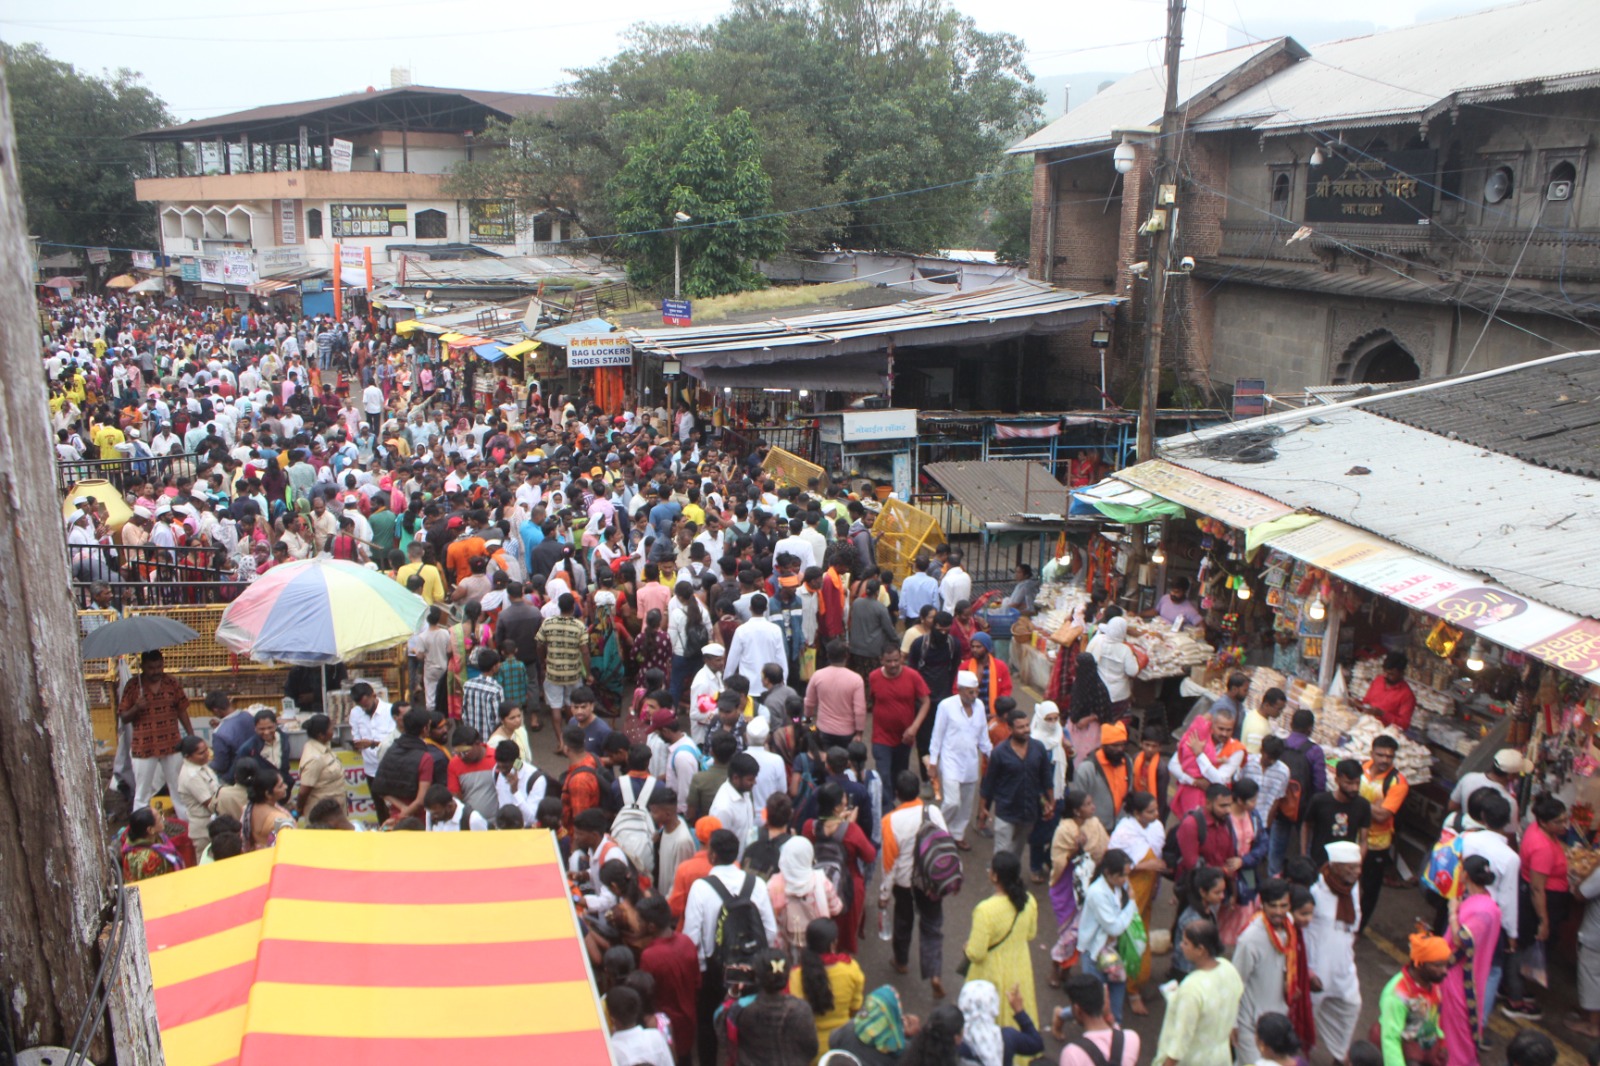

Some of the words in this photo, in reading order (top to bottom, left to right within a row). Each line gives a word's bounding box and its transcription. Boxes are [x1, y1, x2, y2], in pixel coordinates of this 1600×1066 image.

[1316, 174, 1330, 198] श्री
[1386, 172, 1418, 198] मंदिर
[571, 349, 589, 357] BAG
[591, 347, 631, 356] LOCKERS
[571, 357, 600, 366] SHOES
[602, 356, 631, 365] STAND
